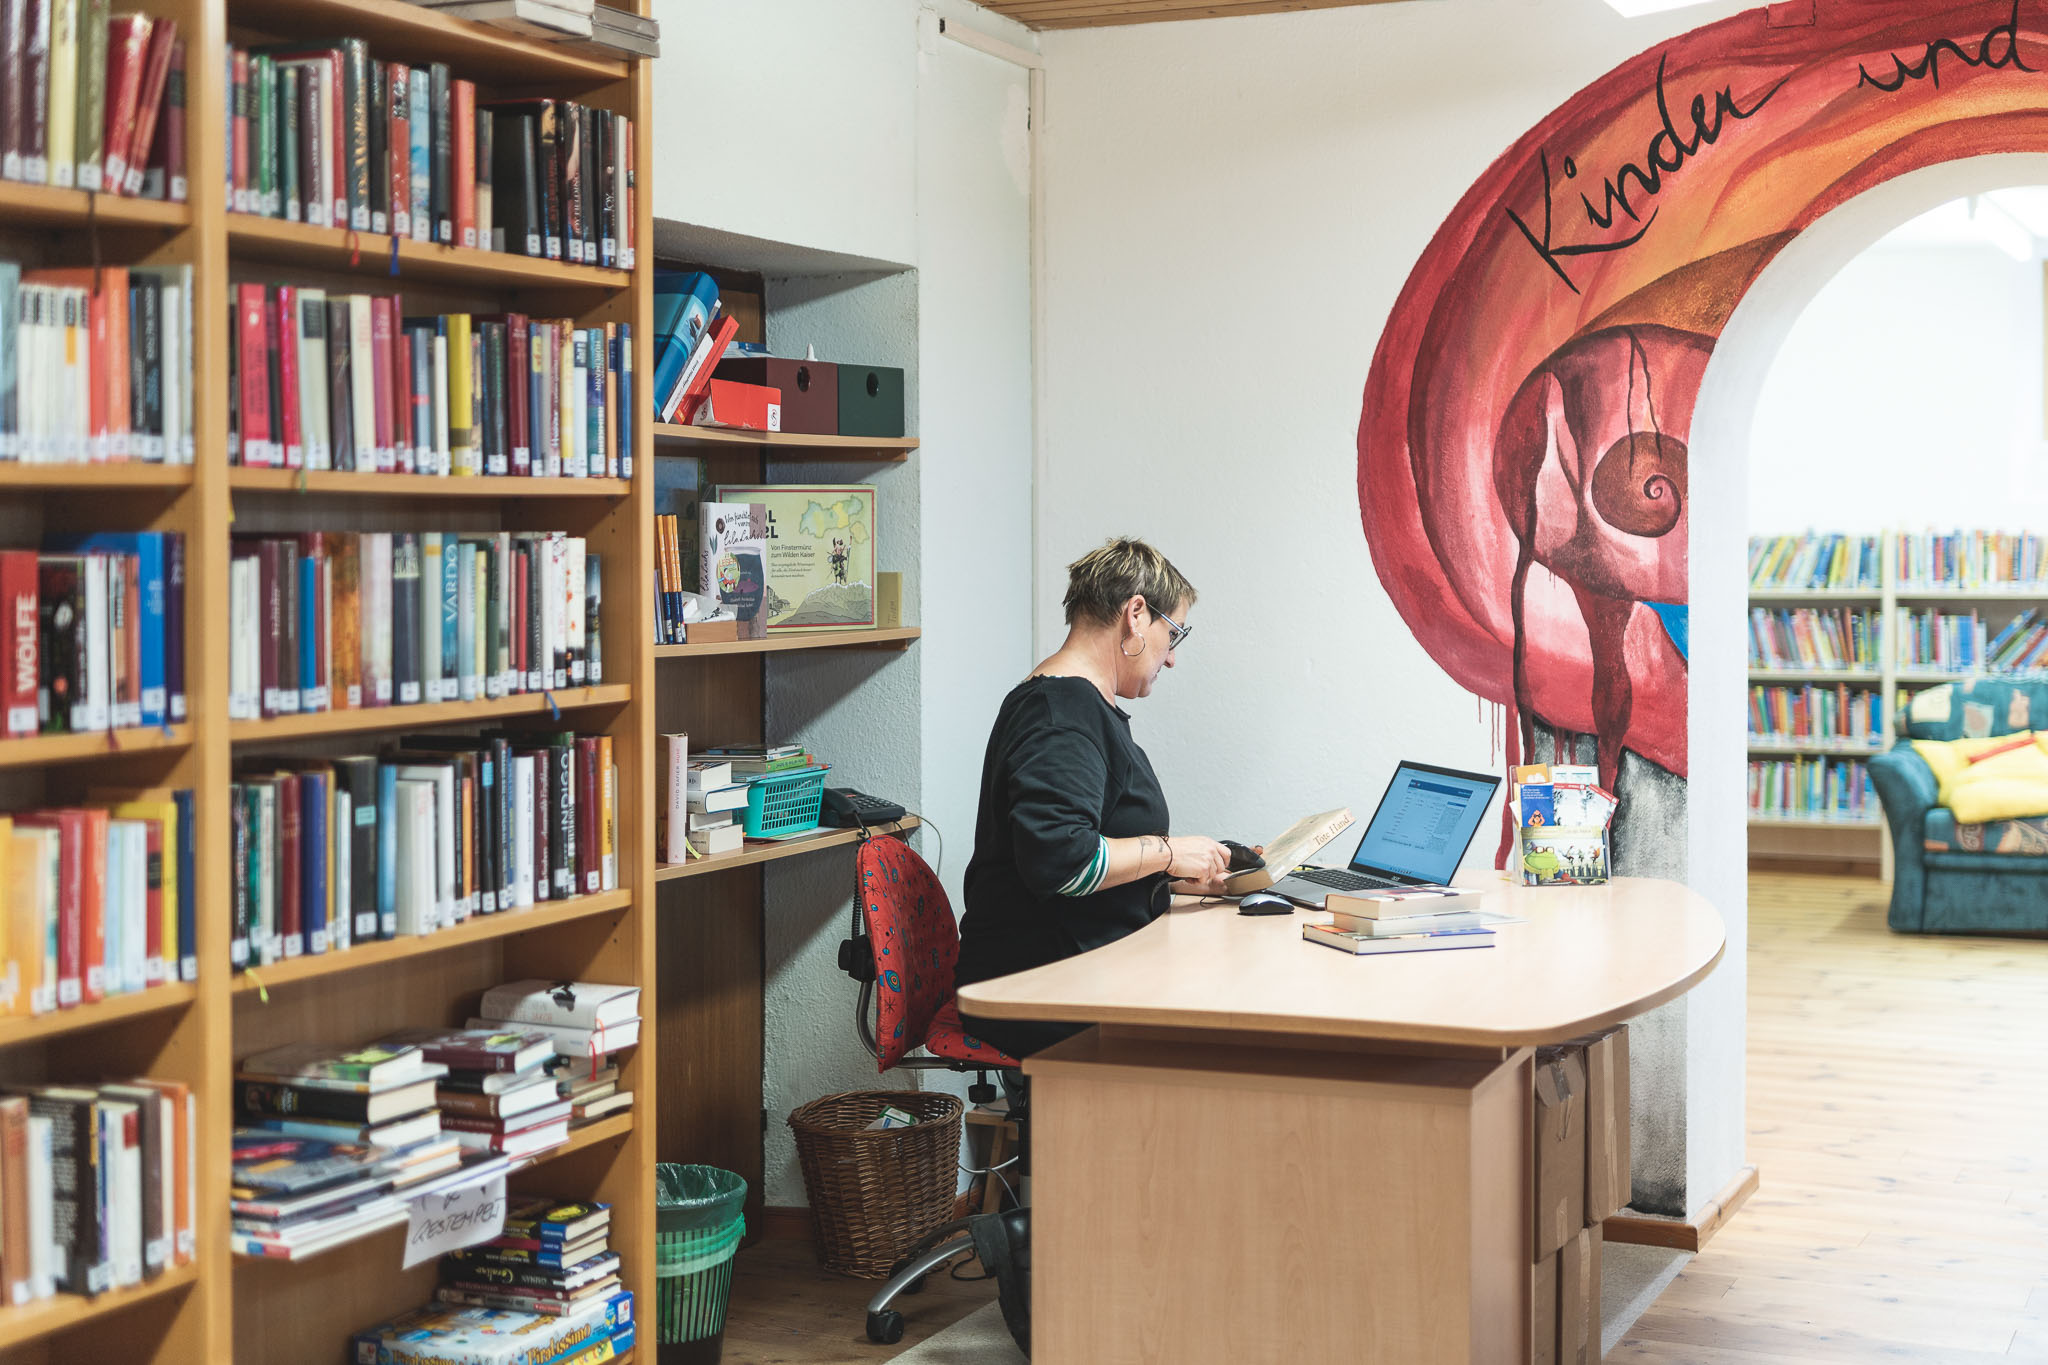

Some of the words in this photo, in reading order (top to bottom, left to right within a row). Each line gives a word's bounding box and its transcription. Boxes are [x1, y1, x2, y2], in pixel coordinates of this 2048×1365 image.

[1505, 50, 1790, 295] Kinder
[1858, 0, 2042, 91] und
[561, 752, 569, 831] INDIGO
[1312, 833, 1331, 846] Tote
[1328, 814, 1350, 835] Hand
[525, 1322, 591, 1365] Piratissimo
